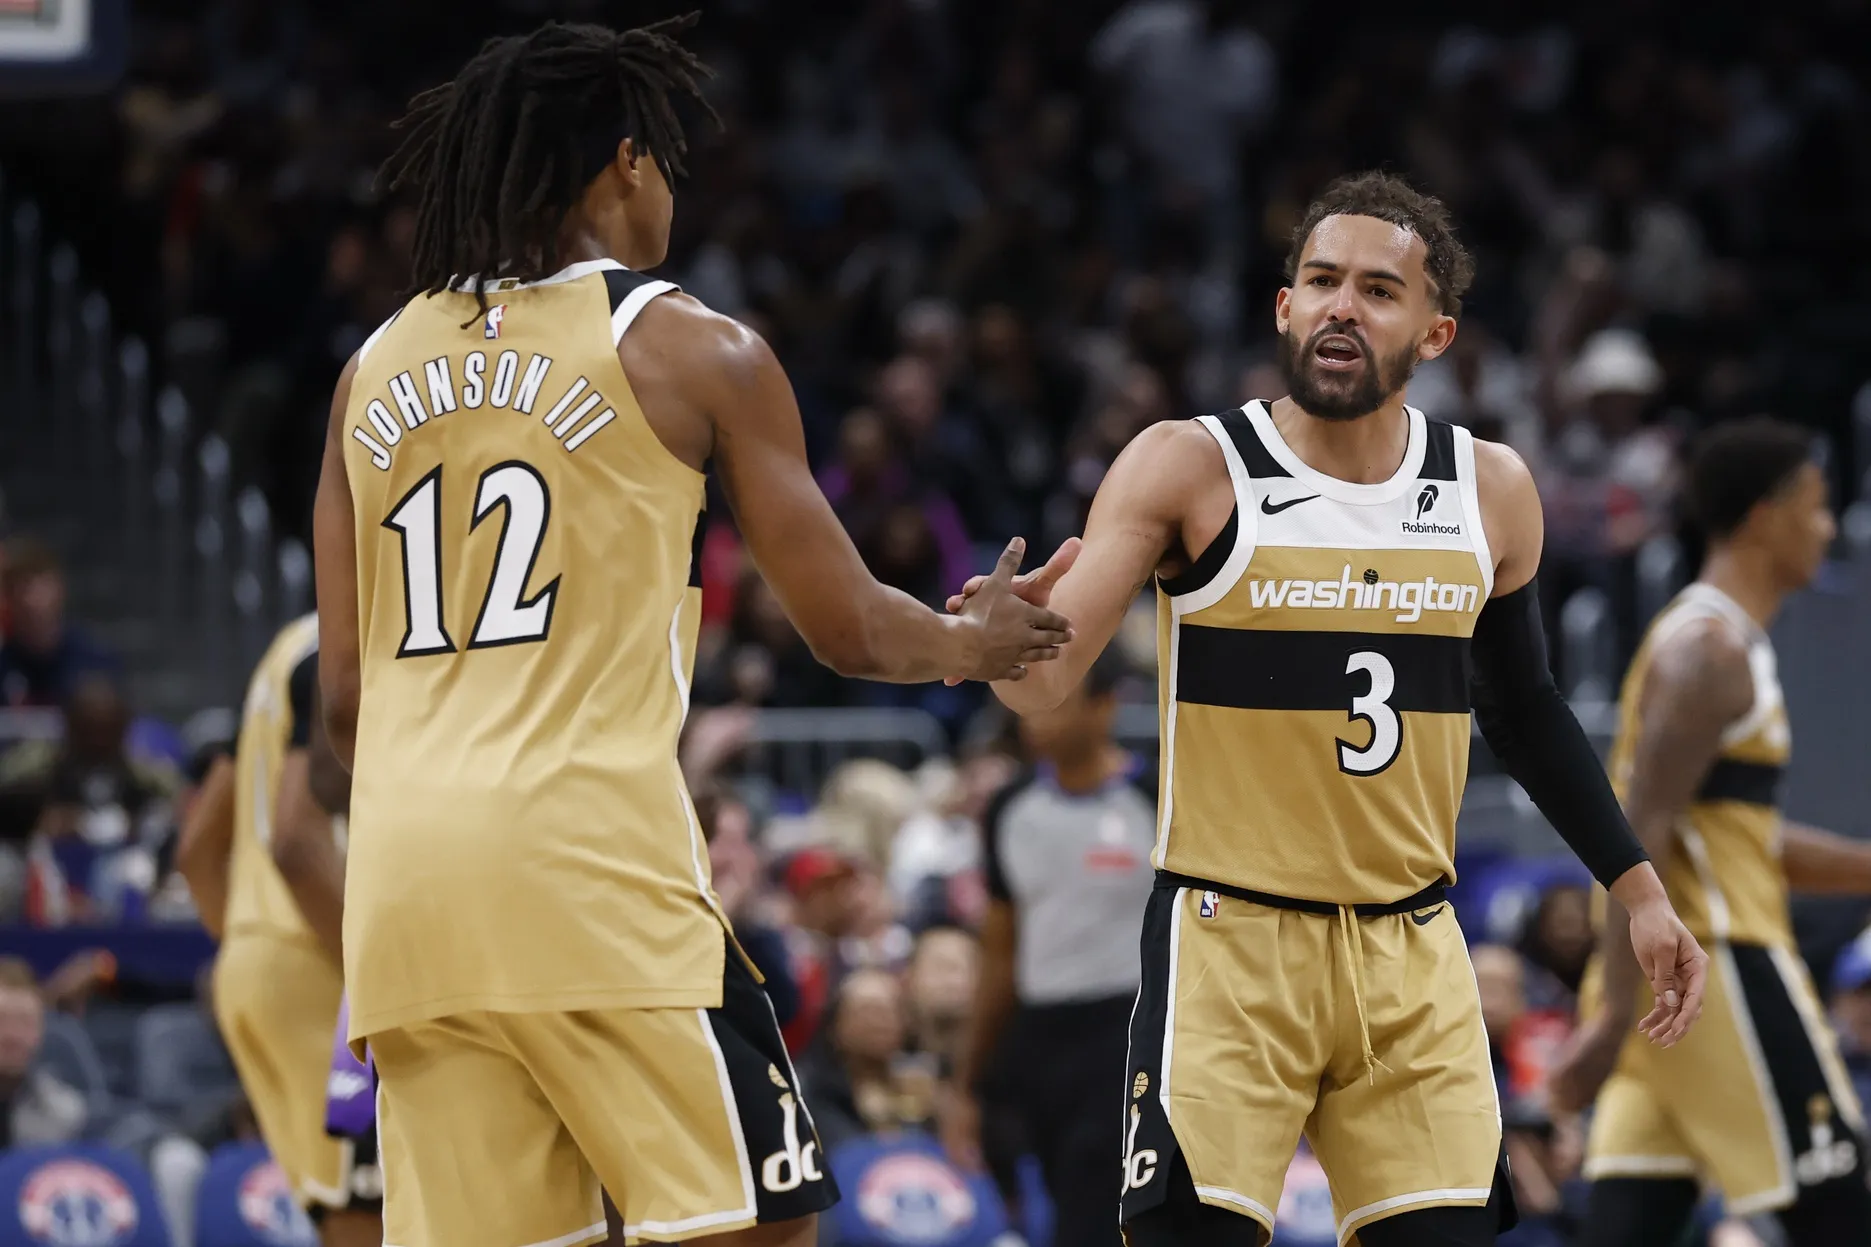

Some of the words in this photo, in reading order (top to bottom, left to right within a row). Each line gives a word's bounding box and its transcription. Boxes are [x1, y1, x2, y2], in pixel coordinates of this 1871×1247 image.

[353, 350, 552, 471] JOHNSON
[544, 376, 616, 452] III
[381, 460, 562, 659] 12
[1402, 522, 1460, 535] Robinhood
[1249, 564, 1479, 623] washington
[1335, 650, 1403, 777] 3
